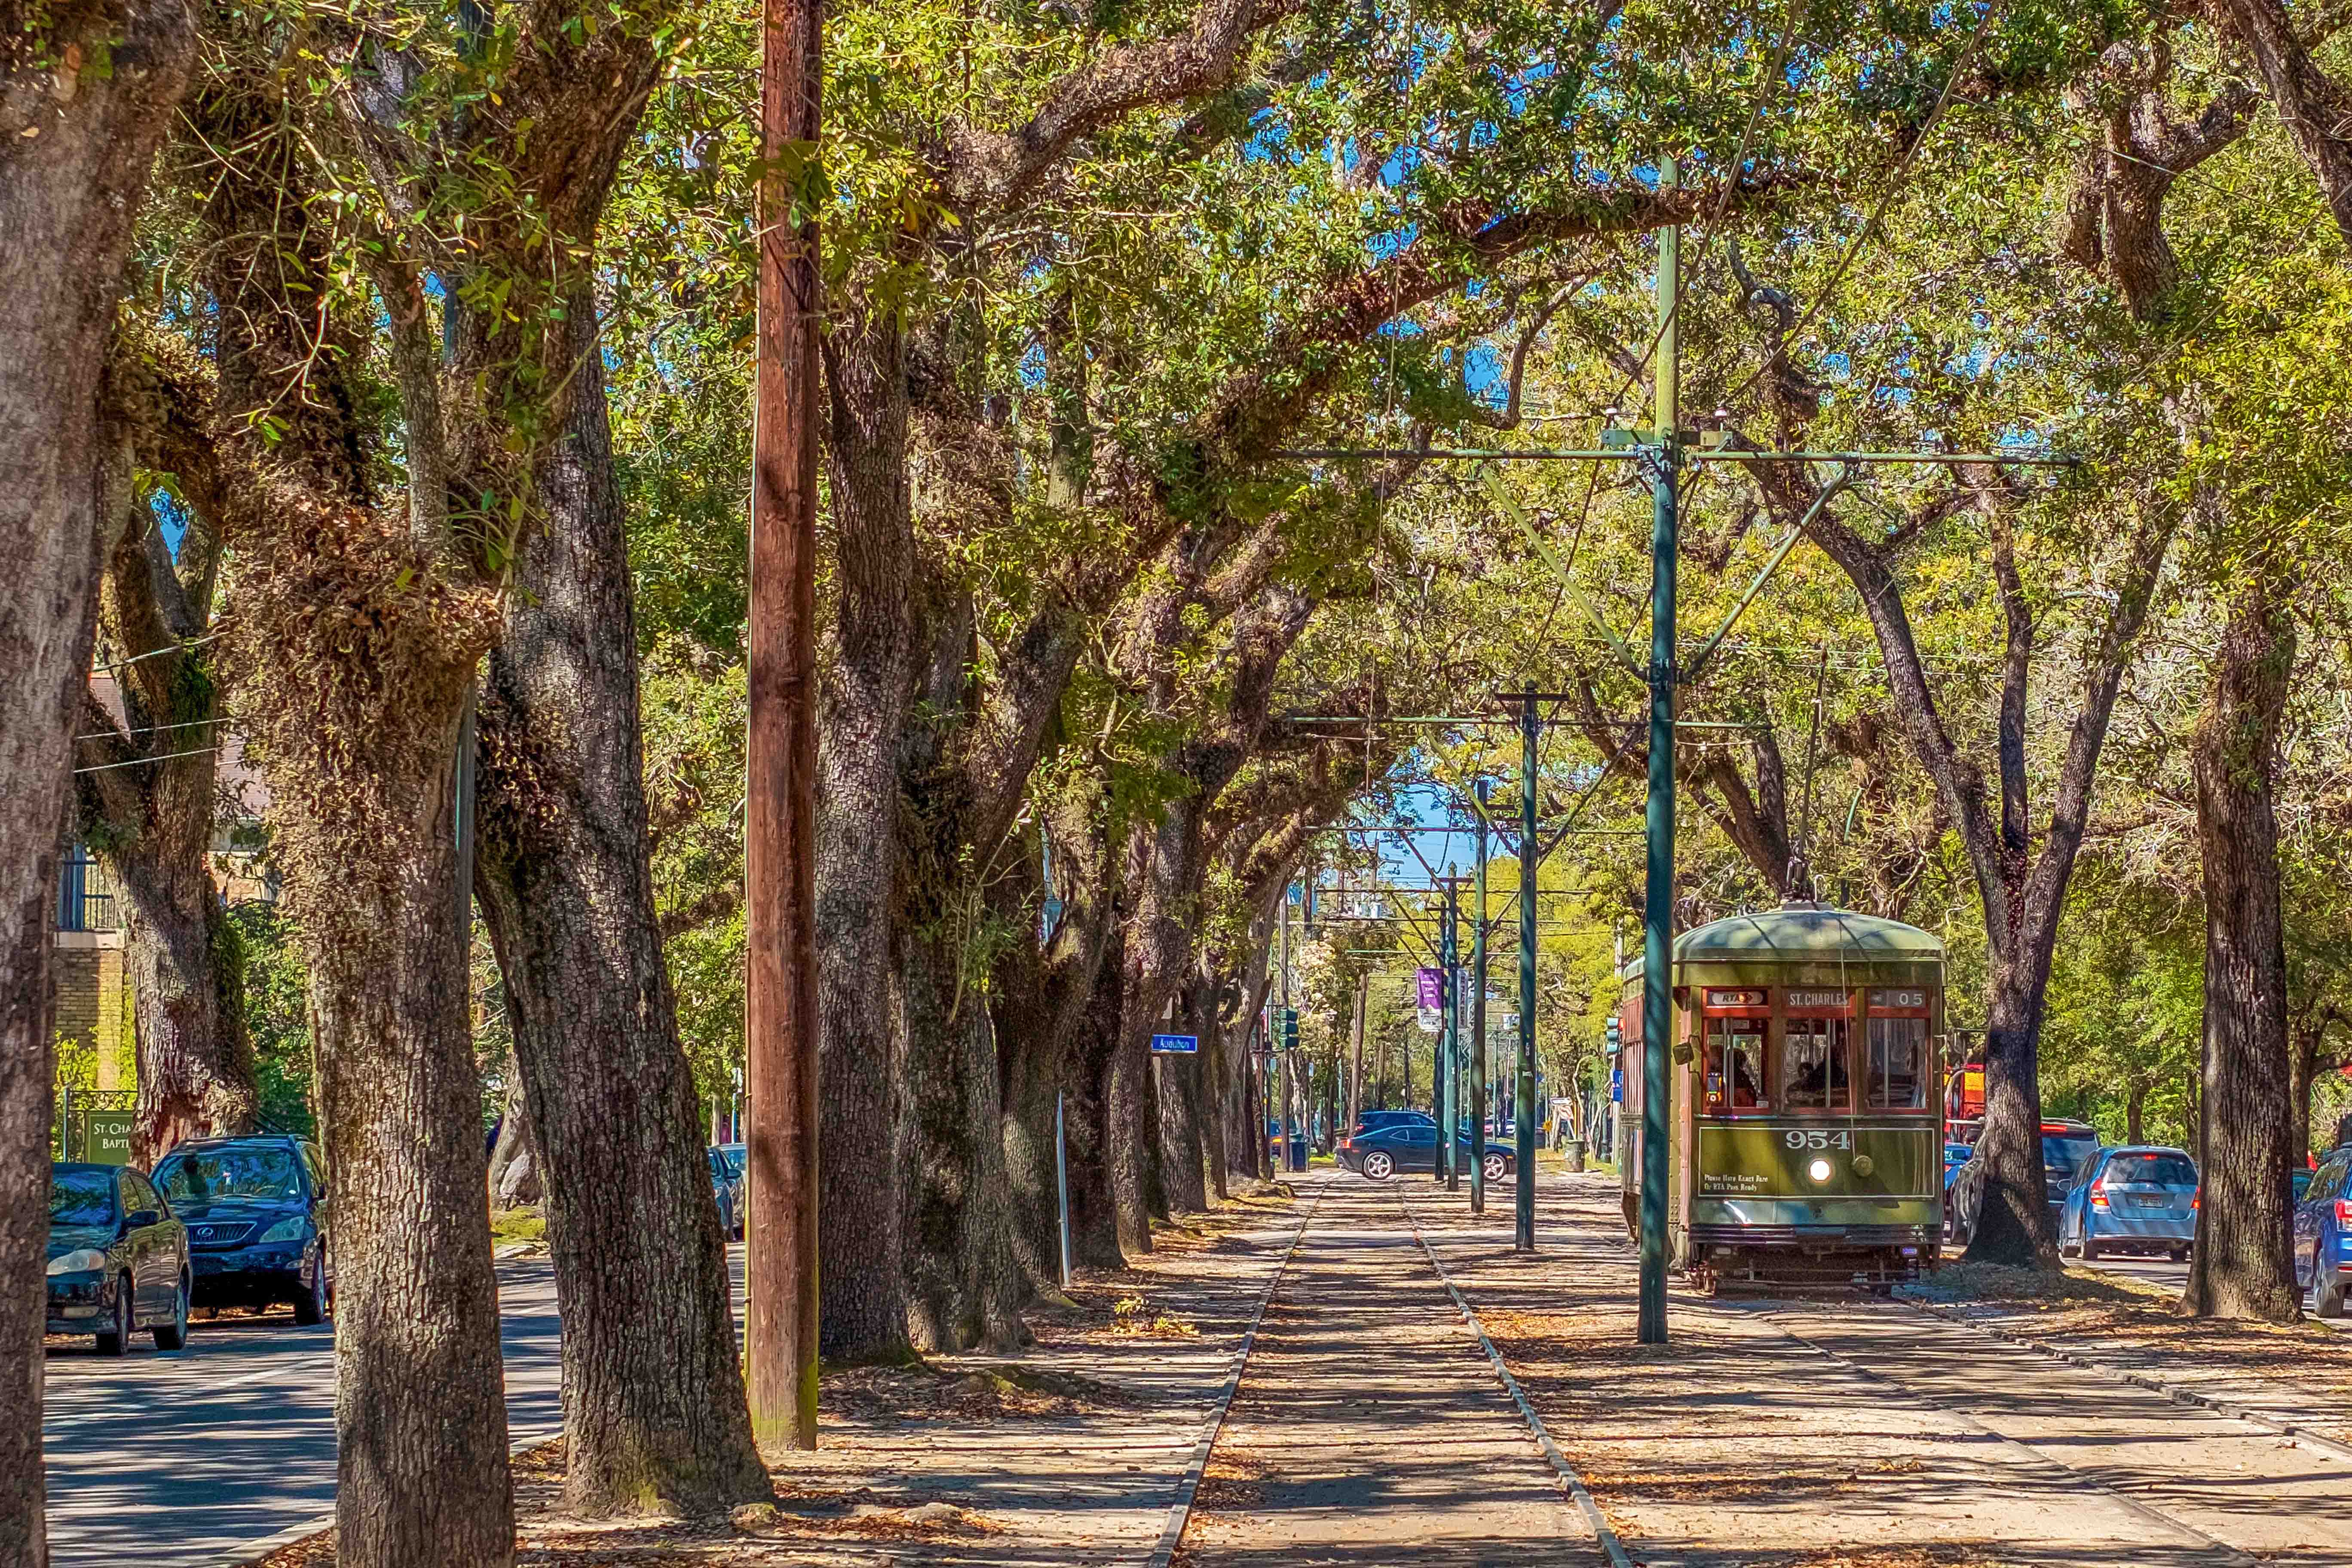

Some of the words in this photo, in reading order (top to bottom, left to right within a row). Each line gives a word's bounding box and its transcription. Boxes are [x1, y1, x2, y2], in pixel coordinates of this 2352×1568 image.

[1790, 993, 1803, 1005] ST.
[1805, 993, 1848, 1005] CHARLES
[1159, 1038, 1190, 1049] Audubon
[109, 1123, 133, 1134] CHA
[102, 1138, 129, 1149] BAPTI
[1786, 1131, 1850, 1150] 954
